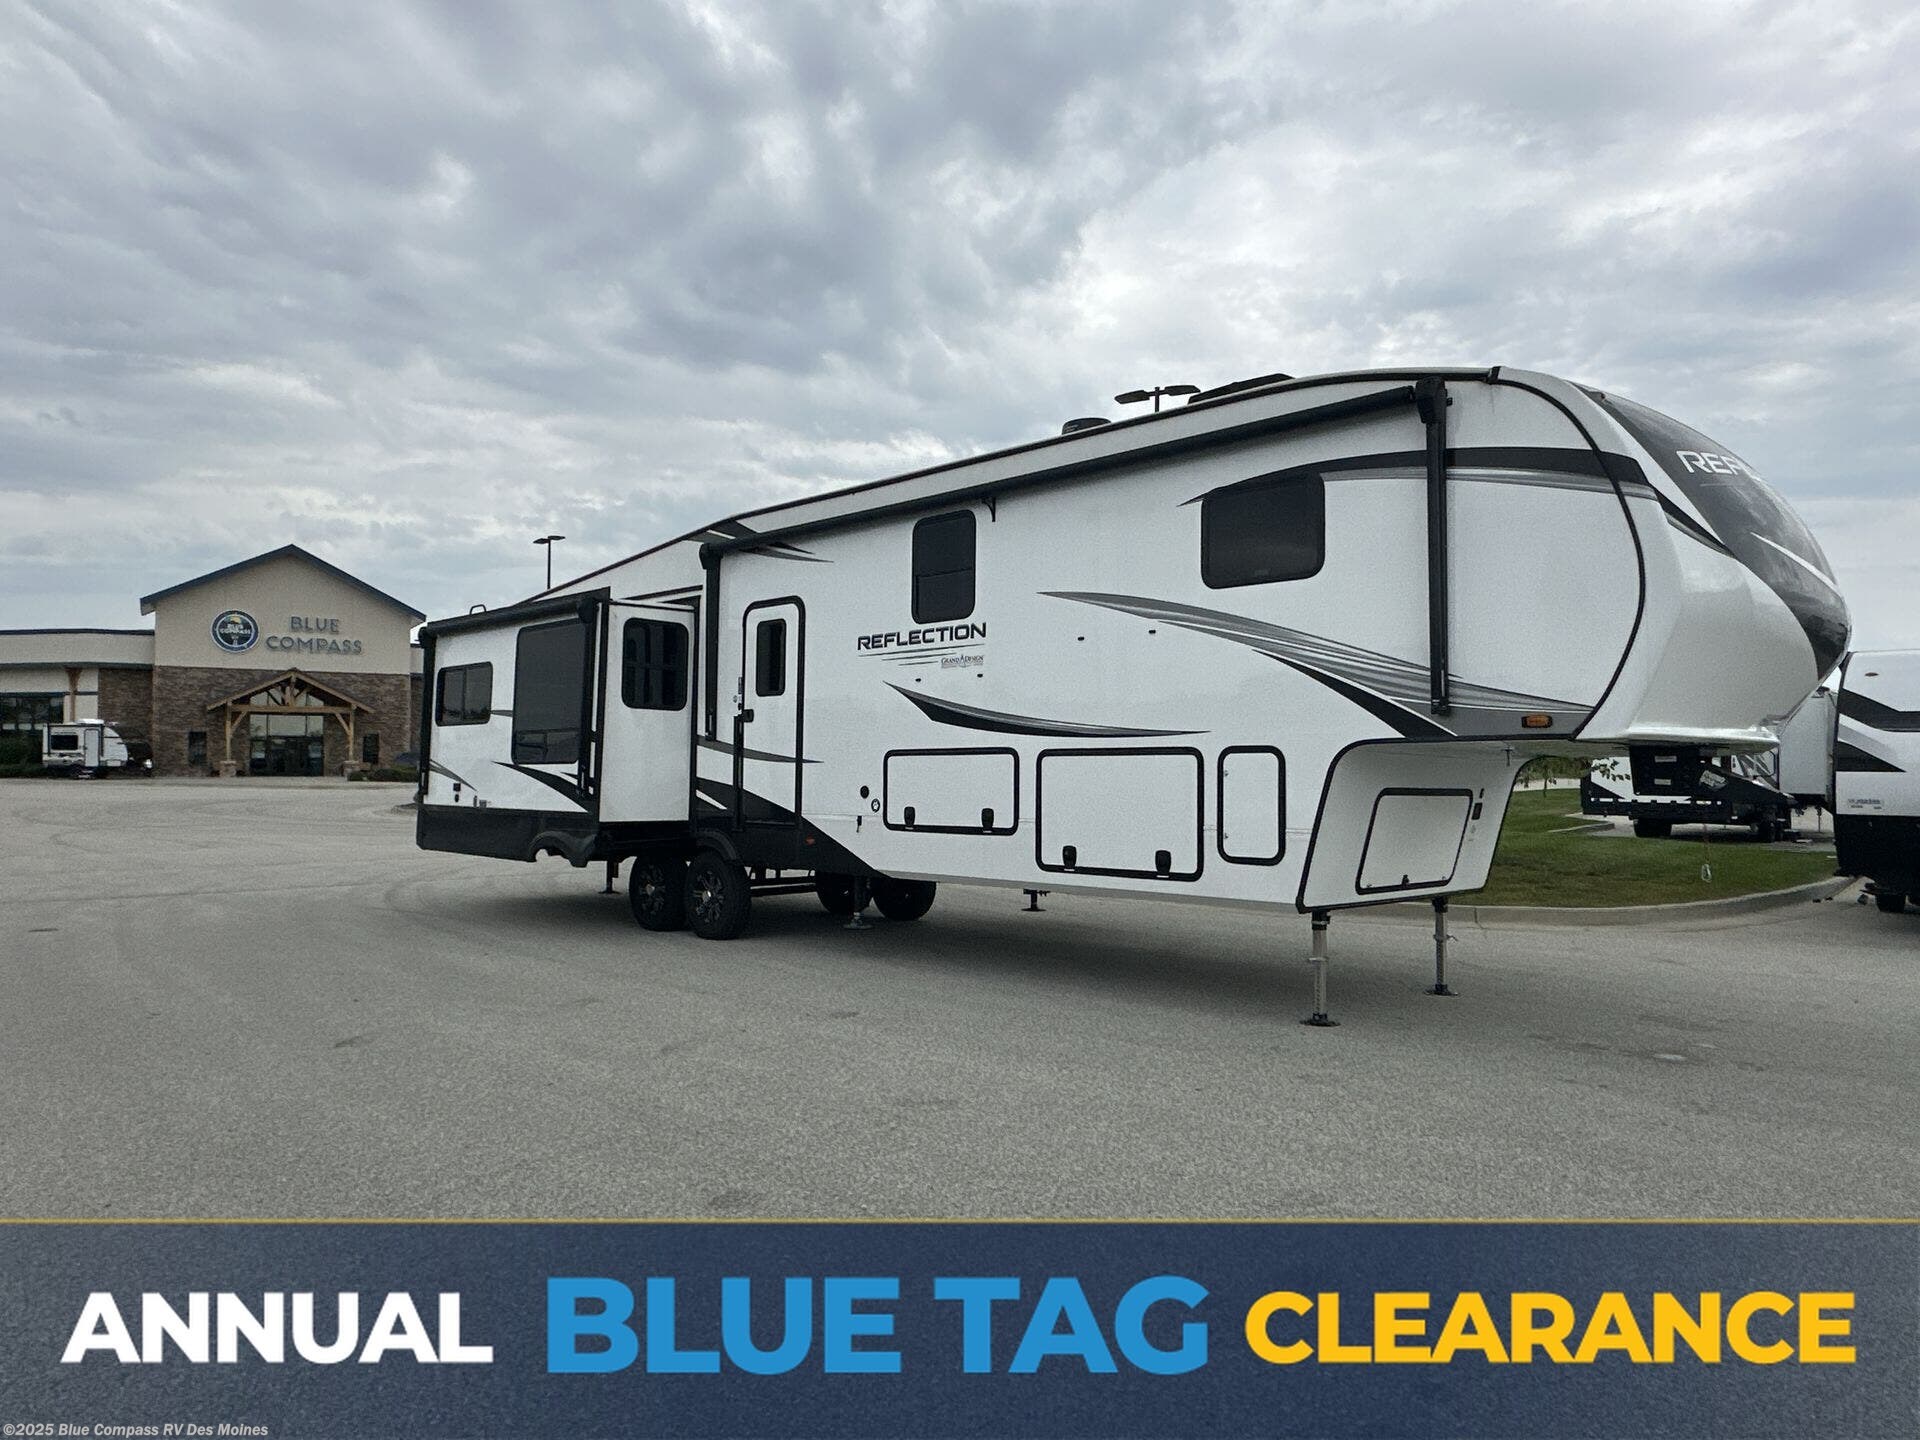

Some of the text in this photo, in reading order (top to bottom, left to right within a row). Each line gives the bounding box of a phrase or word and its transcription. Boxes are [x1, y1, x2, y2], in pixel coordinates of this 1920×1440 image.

[290, 616, 340, 633] BLUE
[266, 635, 362, 654] COMPASS
[857, 622, 987, 651] REFLECTION
